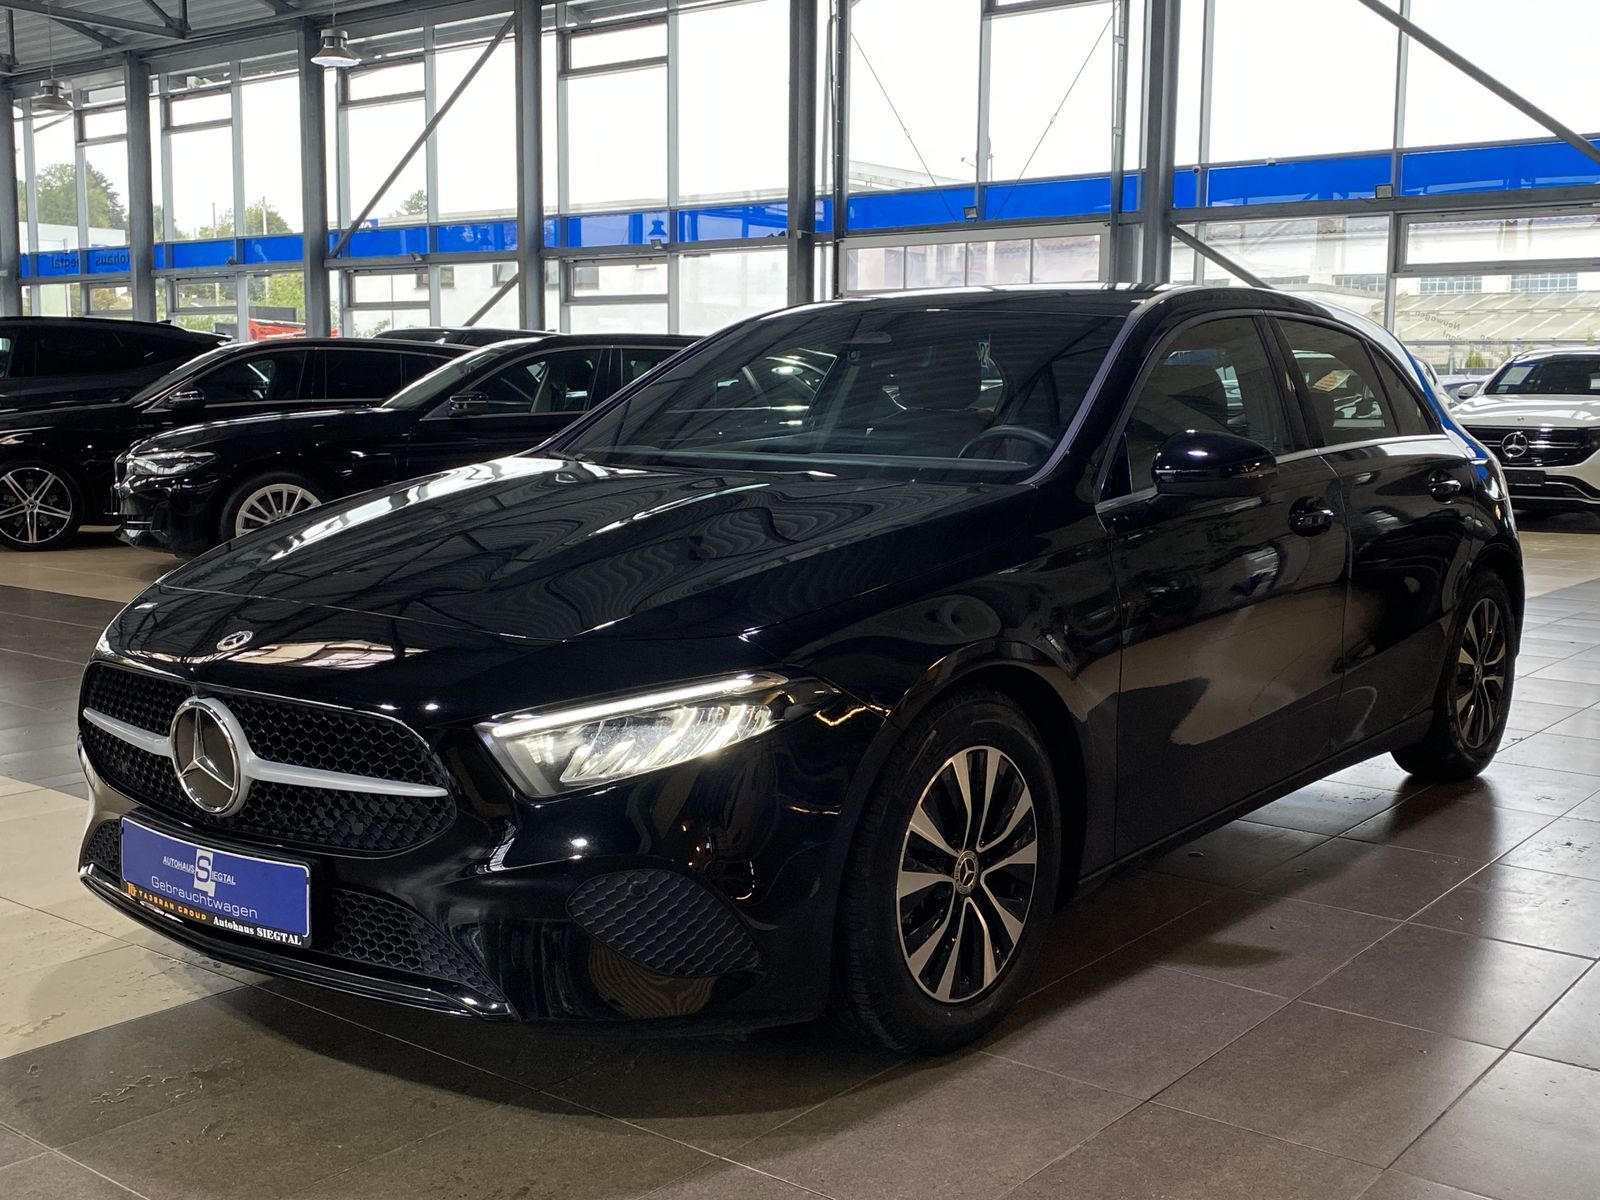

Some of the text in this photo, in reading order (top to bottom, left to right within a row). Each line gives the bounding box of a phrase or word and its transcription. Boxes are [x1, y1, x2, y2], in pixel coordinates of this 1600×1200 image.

[162, 855, 195, 875] AUTOHAUS
[151, 875, 259, 919] Gebrauchtwagen
[177, 905, 208, 921] GROUP
[213, 916, 302, 946] Autohaus SIEGTAL
